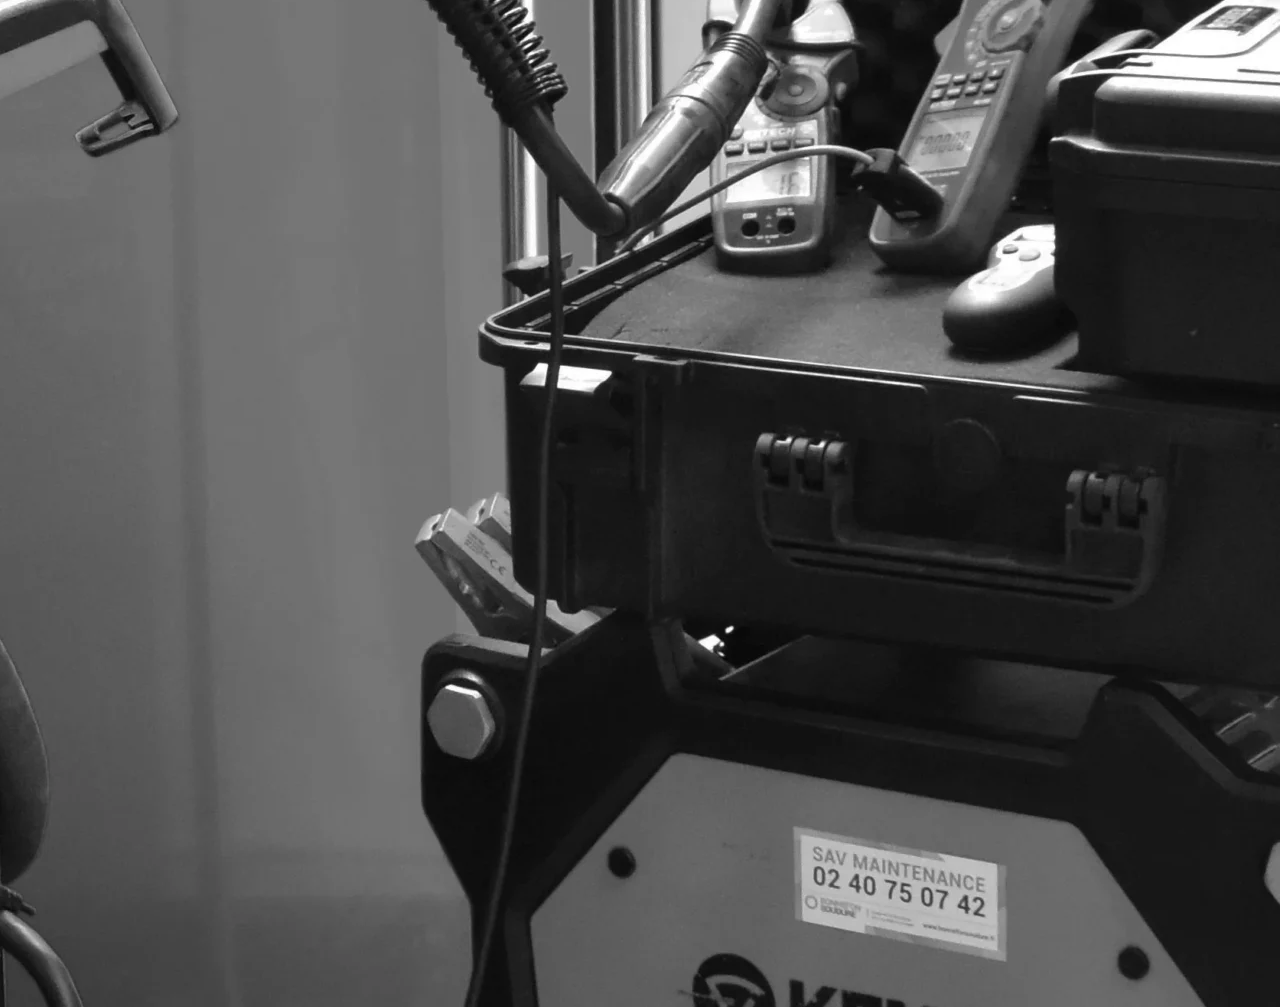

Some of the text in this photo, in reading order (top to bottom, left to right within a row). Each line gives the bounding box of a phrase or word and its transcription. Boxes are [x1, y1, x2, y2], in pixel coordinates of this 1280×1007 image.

[813, 846, 986, 893] SAV MAINTENANCE
[813, 866, 986, 917] 02 40 75 07 42
